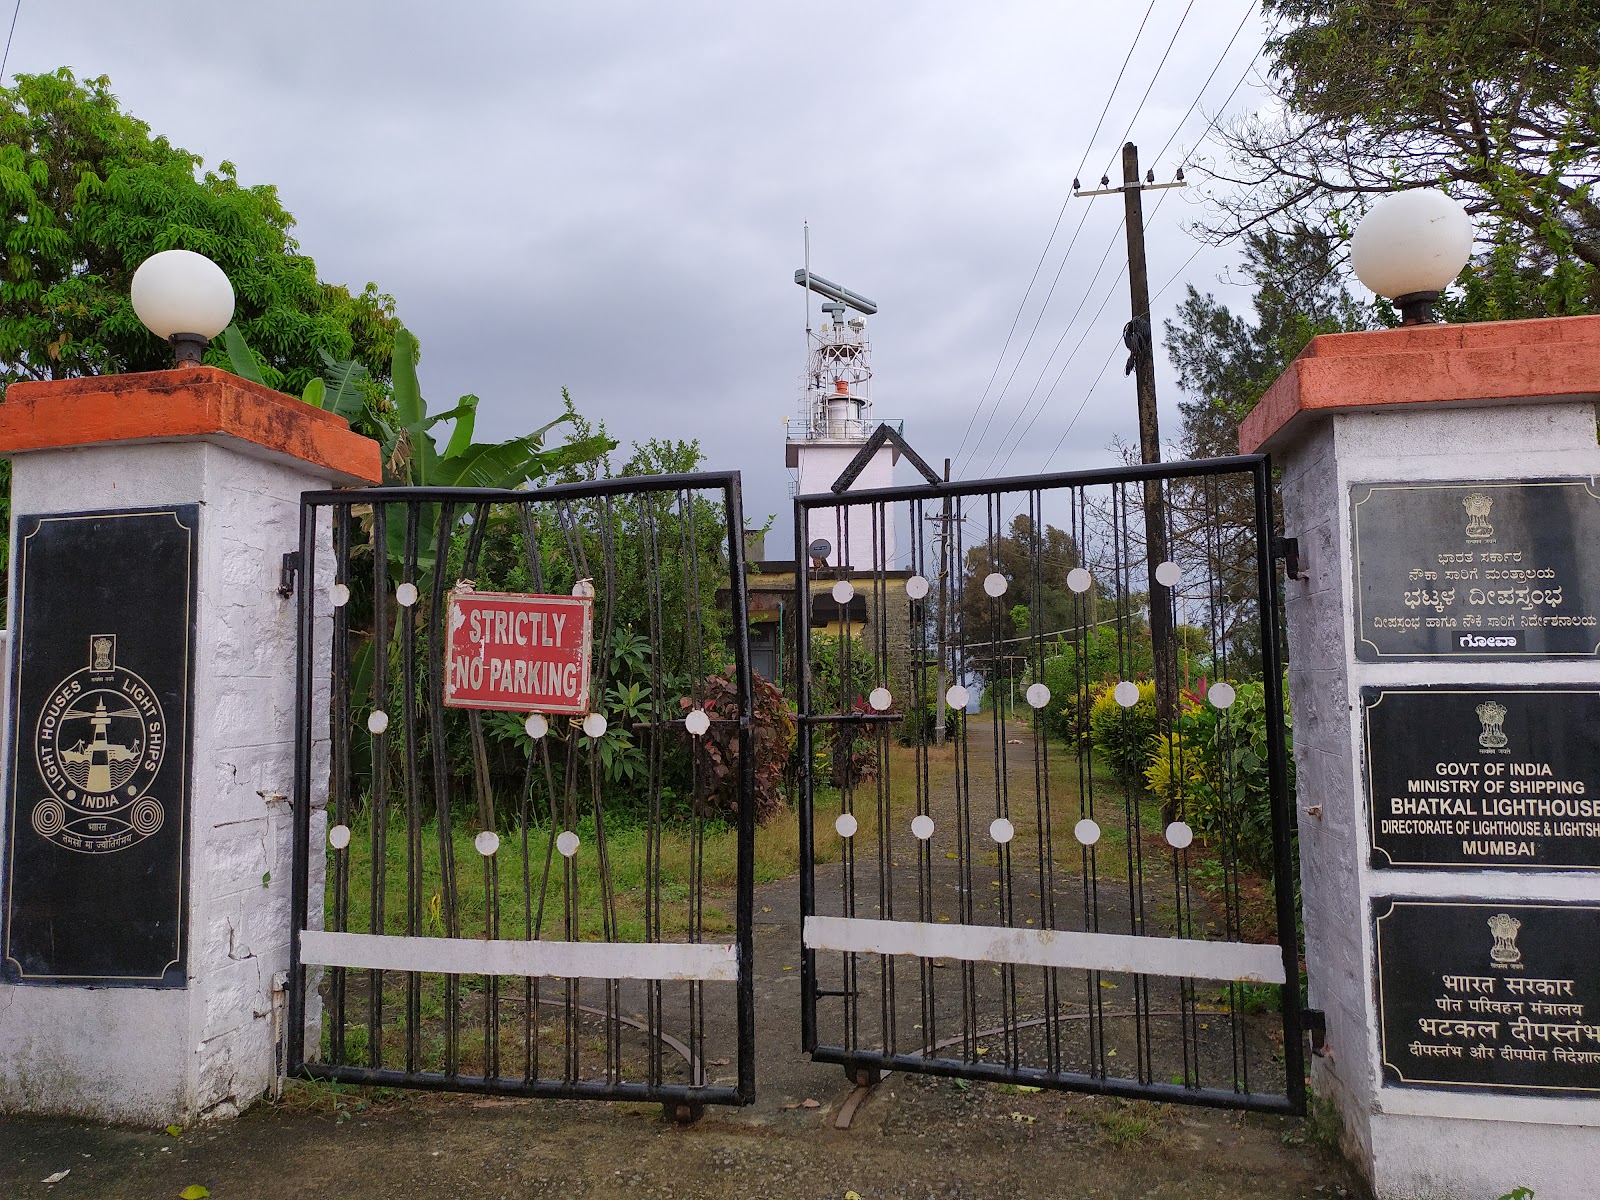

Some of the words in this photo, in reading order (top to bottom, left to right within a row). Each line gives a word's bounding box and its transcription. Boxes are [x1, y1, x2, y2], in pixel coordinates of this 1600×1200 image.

[1438, 551, 1474, 565] ಭಾರತ
[1480, 550, 1522, 562] ಸರ್ಕಾರ
[1444, 567, 1479, 580] ಸಾರಿಗೆ
[1485, 567, 1556, 584] ಮಂತ್ರಾಲಯ
[1404, 587, 1456, 613] ಭಟ್ಕಳ
[1469, 585, 1563, 610] ದೀಪಸ್ತಂಭ
[469, 609, 566, 647] STRICTLY
[1373, 615, 1420, 633] ದೀಪಸ್ತಂಭ
[1459, 633, 1517, 648] ಗೋವಾ
[456, 655, 484, 691] NO
[489, 657, 577, 697] PARKING
[41, 680, 82, 740] HOUSES
[122, 678, 157, 717] LIGHT
[144, 721, 161, 772] SHIPS
[41, 746, 66, 792] LIGHT
[1435, 762, 1480, 776] GOVT
[1484, 762, 1505, 776] OF
[1509, 763, 1553, 776] INDIA
[1408, 780, 1480, 793] MINISTRY
[1484, 780, 1505, 794] OF
[1509, 780, 1585, 795] SHIPPING
[81, 793, 120, 809] INDIA
[1391, 798, 1477, 815] BHATKAL
[1482, 799, 1600, 817] LIGHTHOUSE
[1381, 819, 1453, 835] DIRECTORATE
[1456, 820, 1470, 835] OF
[1473, 821, 1541, 837] LIGHTHOUSE
[1543, 821, 1552, 837] &
[1462, 841, 1535, 856] MUMBAI
[1503, 977, 1574, 996] सरकार
[1435, 994, 1463, 1012] पोत
[1468, 996, 1524, 1015] परिवहन
[1529, 1000, 1584, 1016] मंत्रालय
[1418, 1018, 1500, 1039] भटकल
[1508, 1016, 1600, 1043] दीपस्तंभ
[1408, 1041, 1463, 1058] दीपस्तंभ
[1469, 1043, 1495, 1059] और
[1500, 1045, 1548, 1062] दीपपोत
